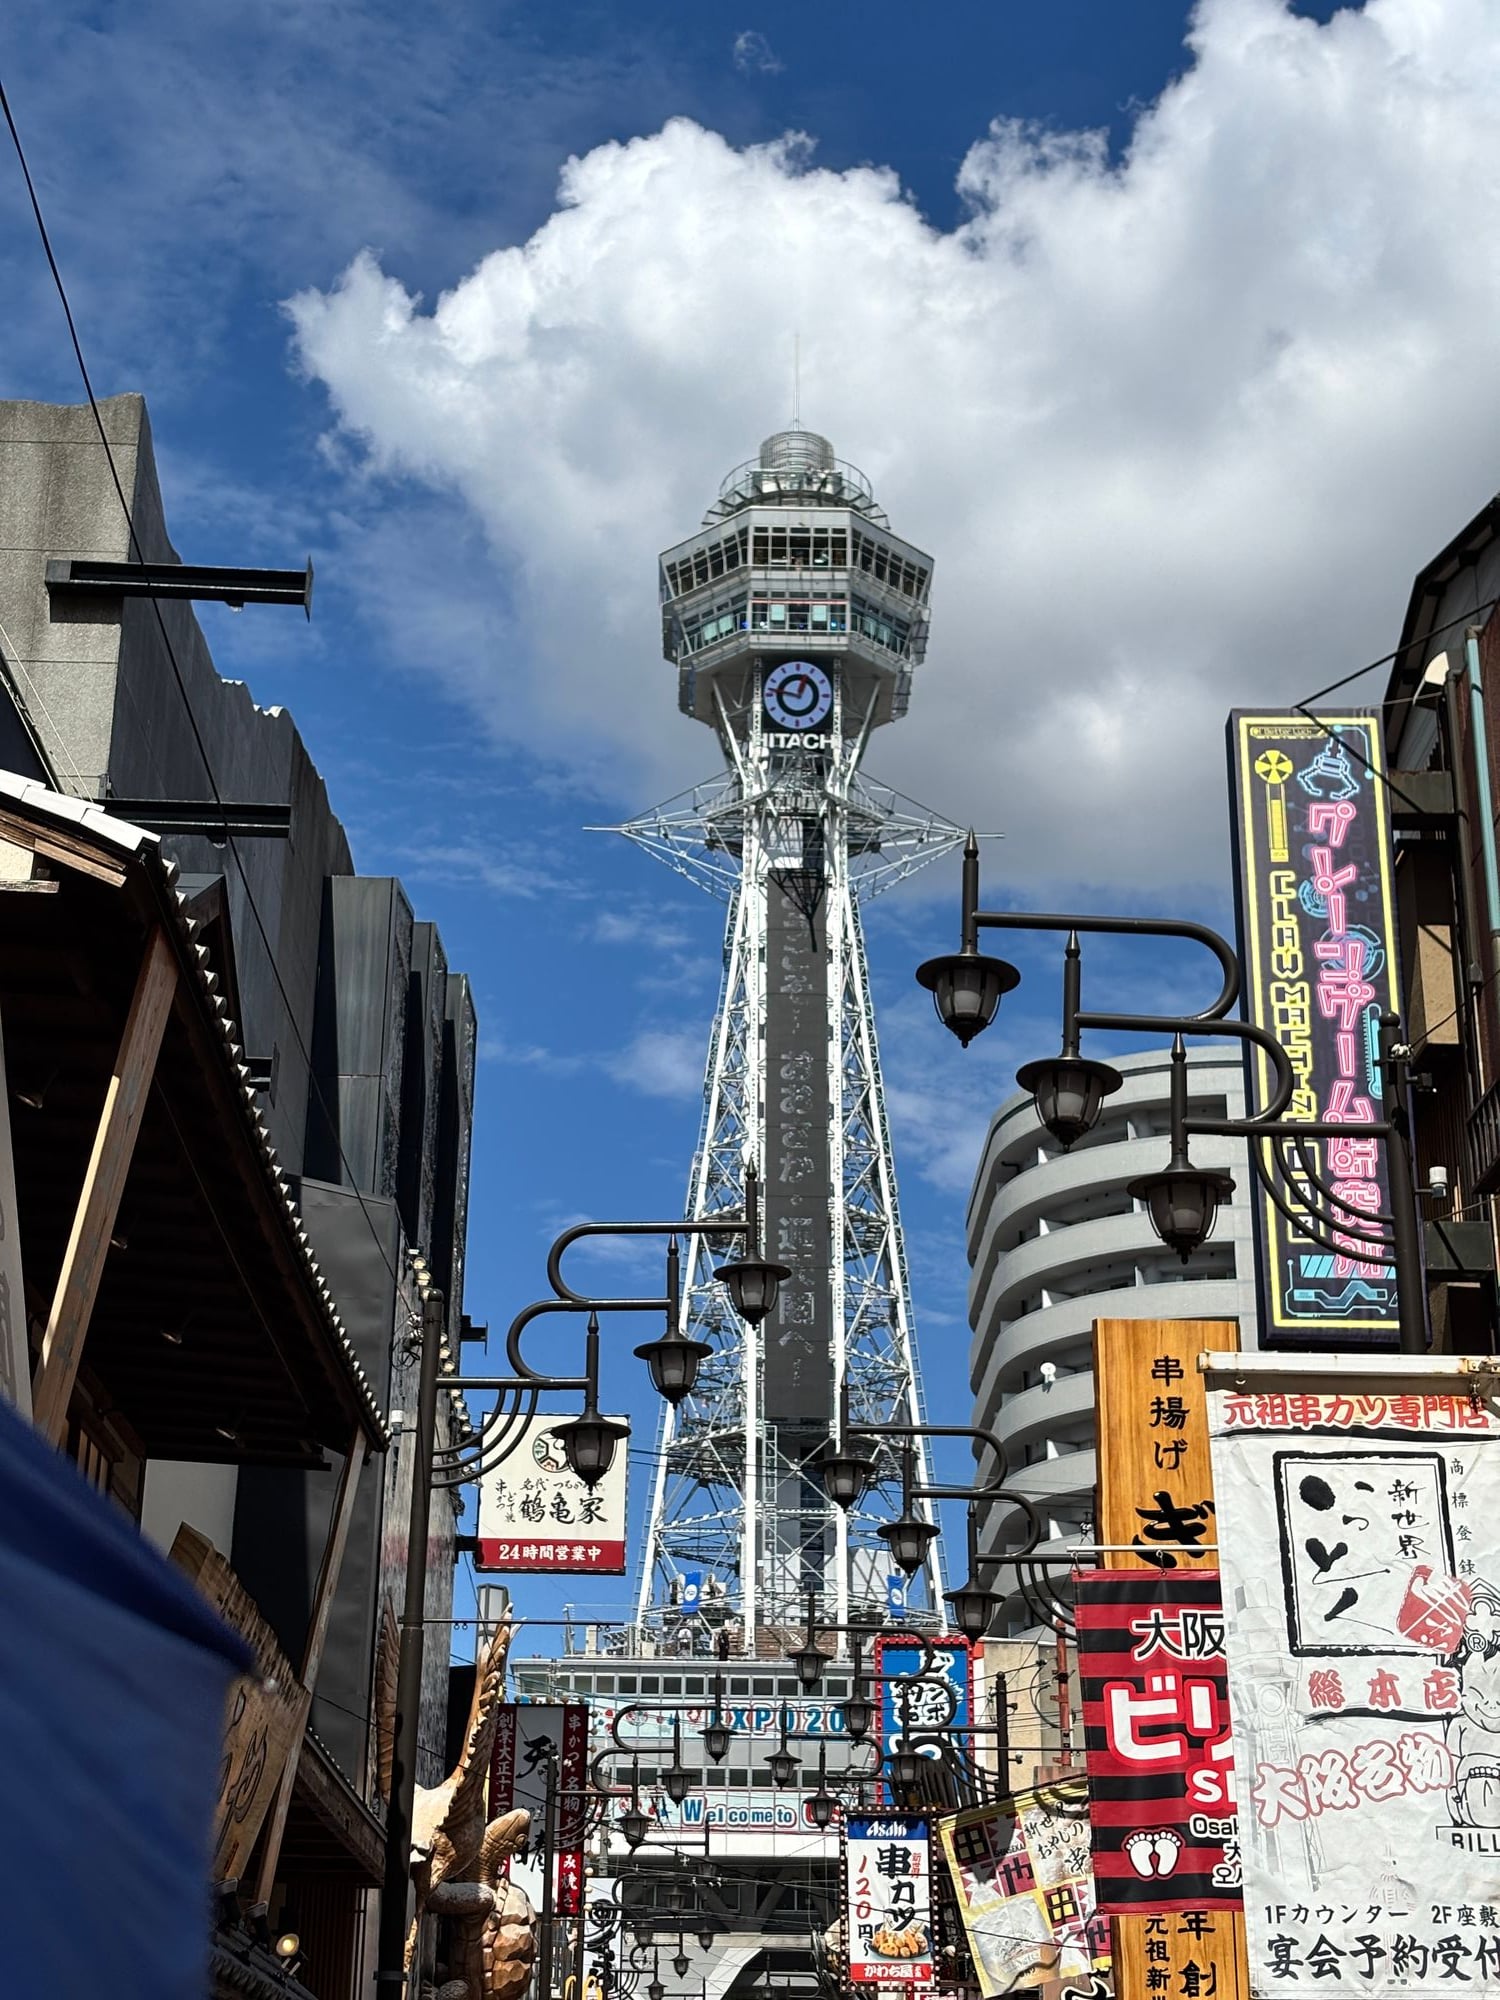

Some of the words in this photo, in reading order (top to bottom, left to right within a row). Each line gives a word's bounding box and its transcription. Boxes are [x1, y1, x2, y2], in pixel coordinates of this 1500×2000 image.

[1150, 1355, 1190, 1470] 串揚げ
[1223, 1394, 1490, 1429] 元祖串カツ専門店
[520, 1489, 608, 1525] 鶴亀家
[1387, 1479, 1431, 1560] 新世界
[1450, 1457, 1476, 1575] 商標登録
[499, 1544, 602, 1562] 24時間営業中
[1134, 1611, 1227, 1658] 大阪
[1308, 1668, 1461, 1710] 総本店
[1253, 1733, 1453, 1828] 大阪名物
[684, 1798, 773, 1822] Welcome
[866, 1821, 908, 1838] Asahi
[875, 1842, 917, 1932] 串カツ
[1264, 1903, 1409, 1926] 1Fカウンター
[863, 1964, 914, 1979] かわち屋
[1144, 1913, 1172, 2000] 元祖新
